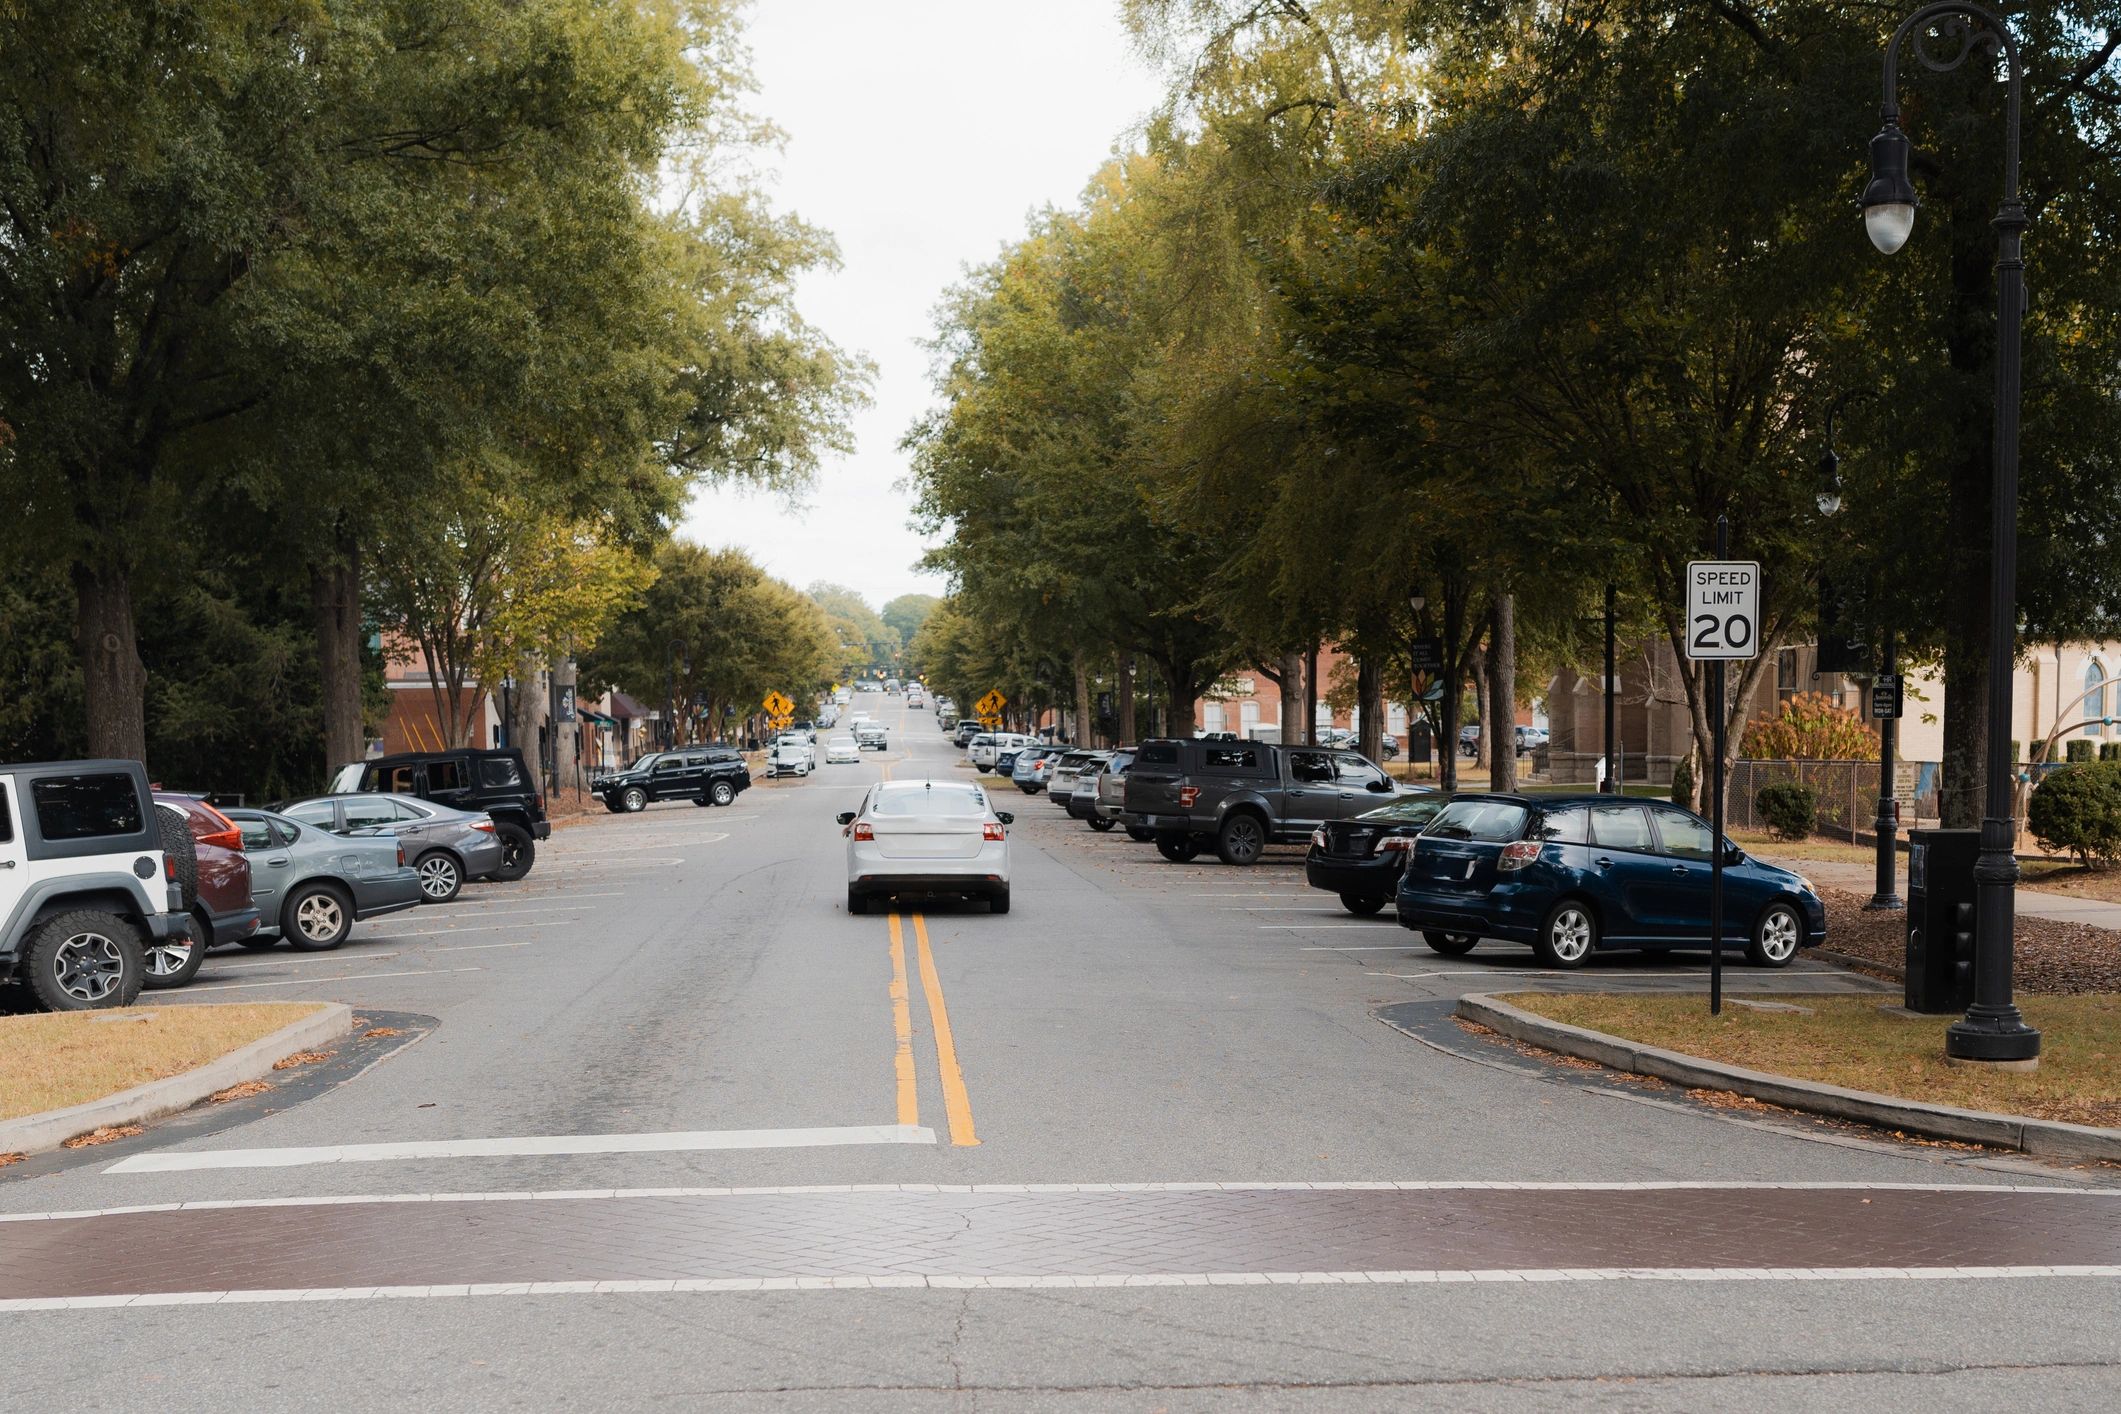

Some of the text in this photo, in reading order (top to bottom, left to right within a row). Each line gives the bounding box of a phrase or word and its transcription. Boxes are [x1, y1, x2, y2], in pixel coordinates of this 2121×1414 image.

[1696, 572, 1751, 585] SPEED
[1702, 591, 1744, 605] LIMIT
[1693, 614, 1751, 649] 20
[1873, 676, 1879, 687] 2
